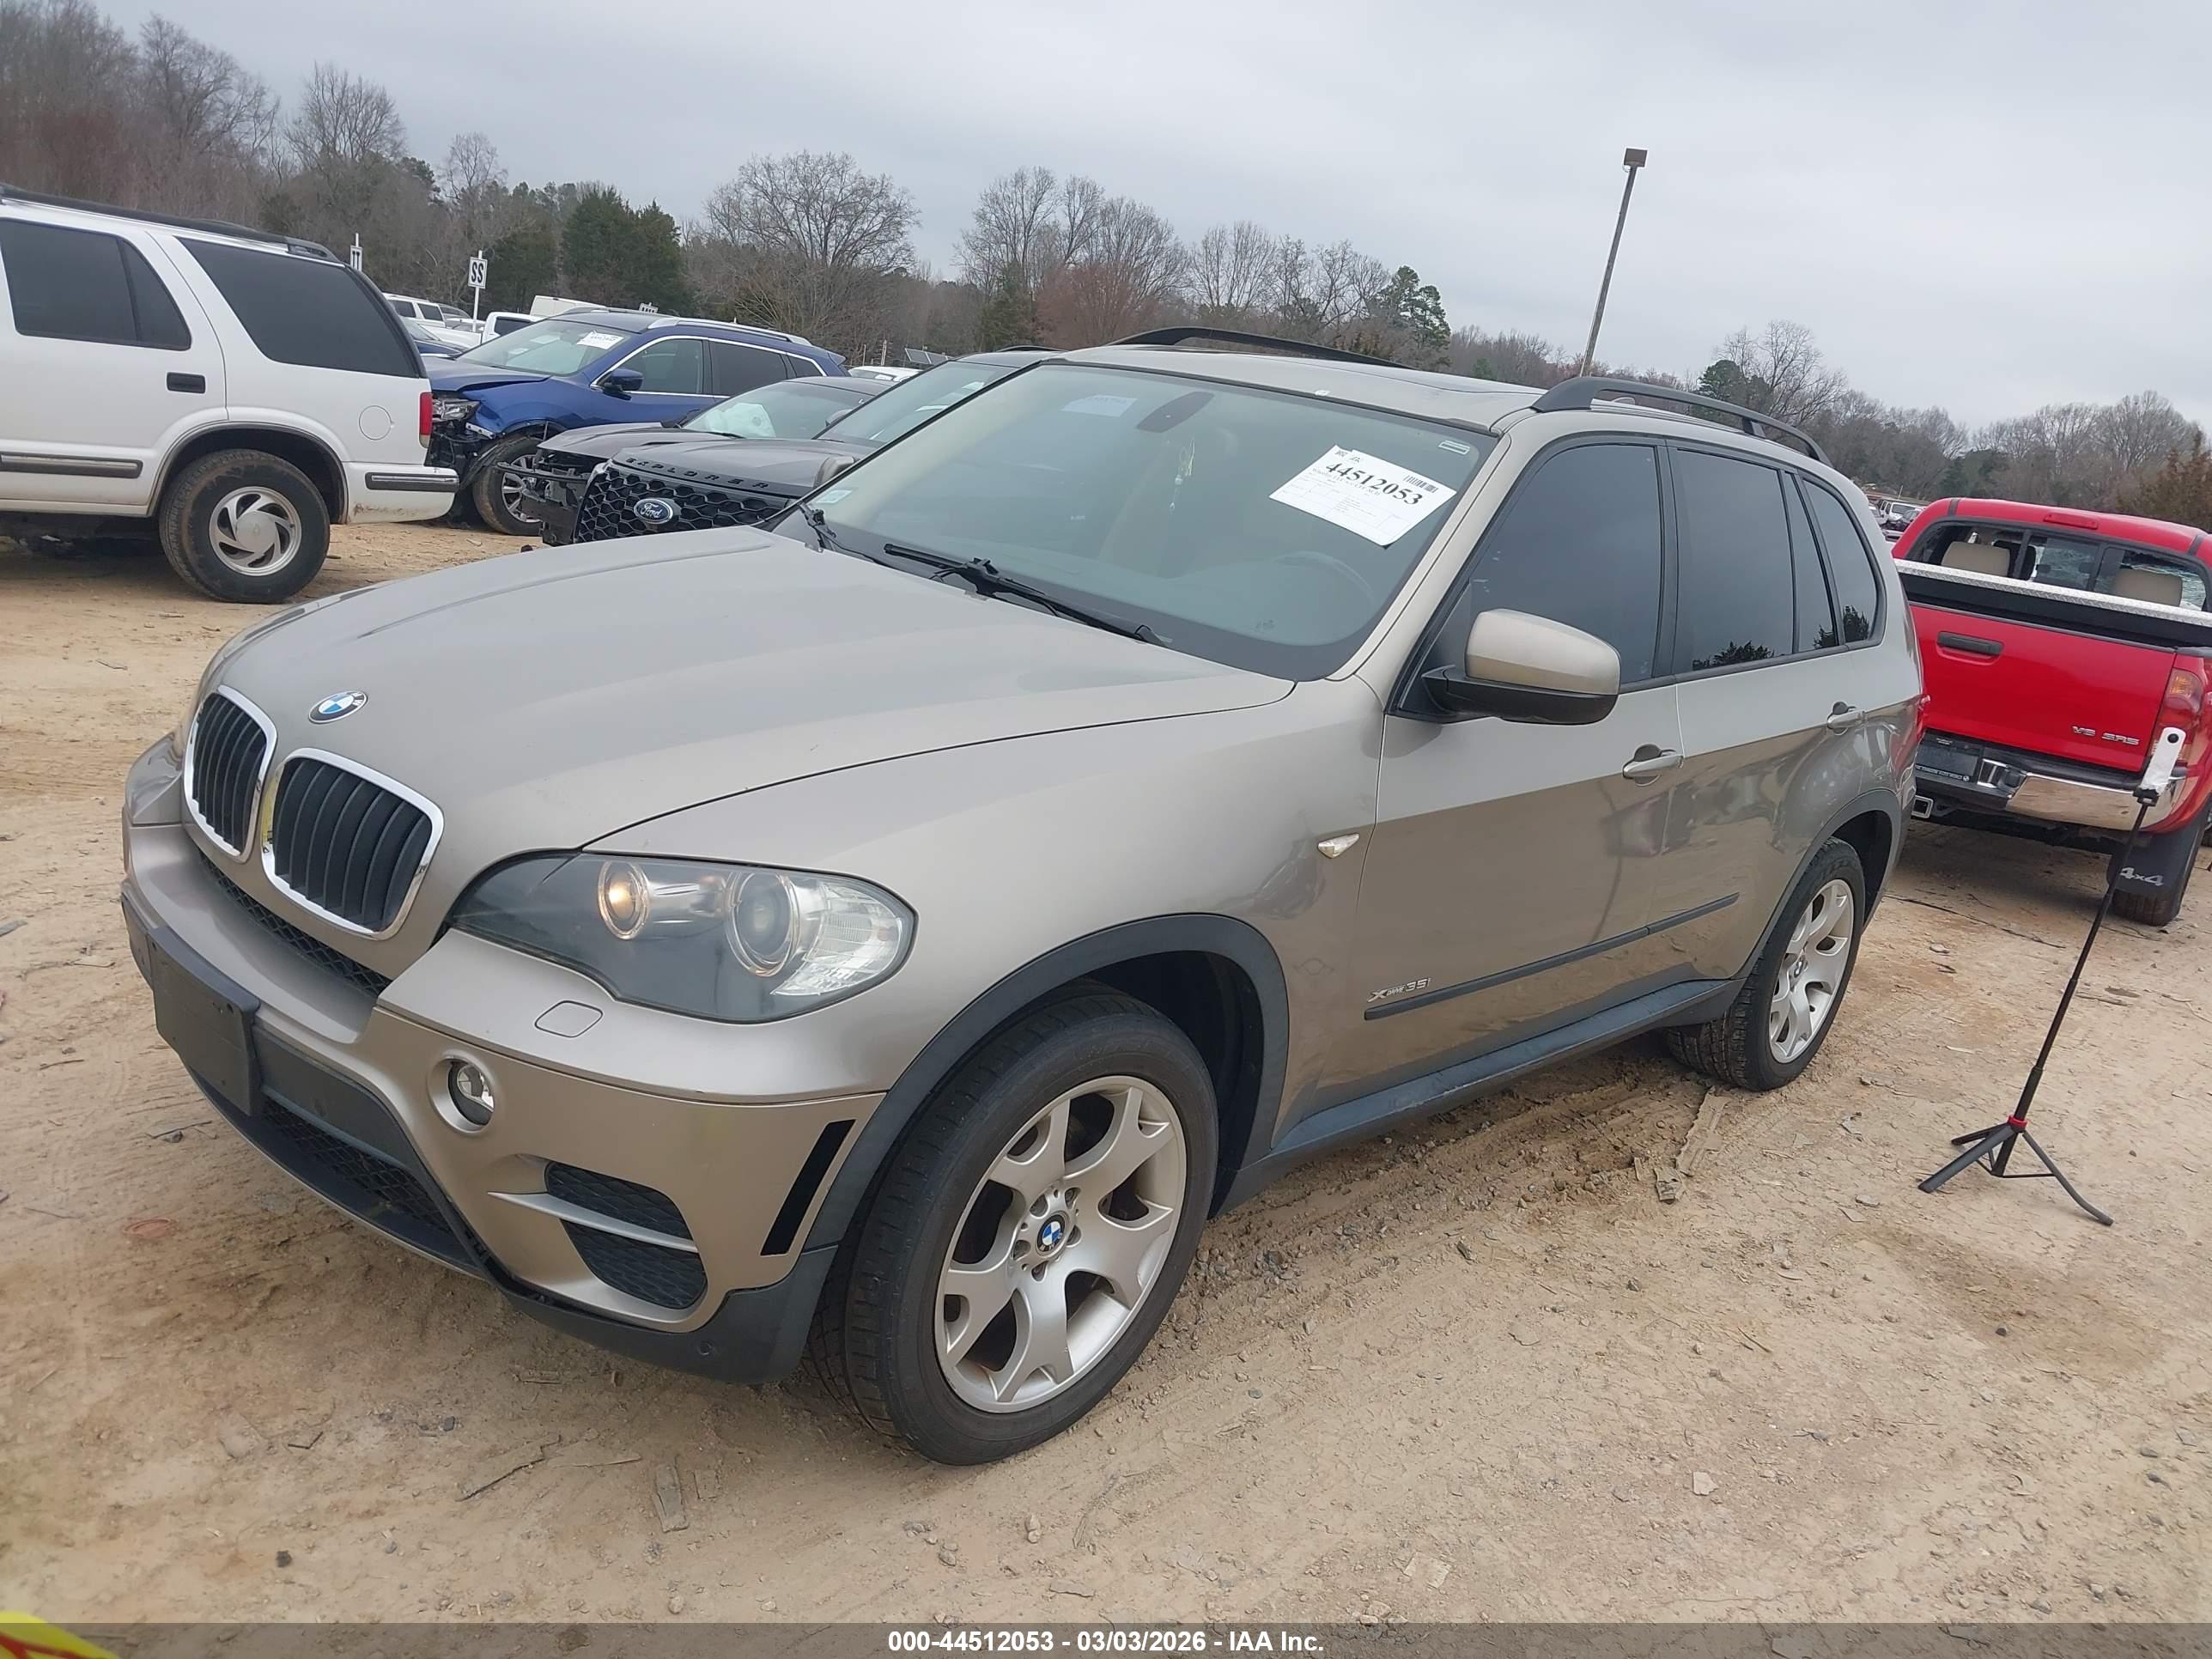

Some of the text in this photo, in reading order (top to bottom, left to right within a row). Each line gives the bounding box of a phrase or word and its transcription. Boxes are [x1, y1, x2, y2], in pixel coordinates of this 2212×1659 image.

[471, 261, 484, 283] SS
[626, 457, 769, 489] EXPLORER
[1325, 463, 1424, 505] 44512053
[641, 502, 662, 519] Ford
[2120, 866, 2164, 886] 4x4
